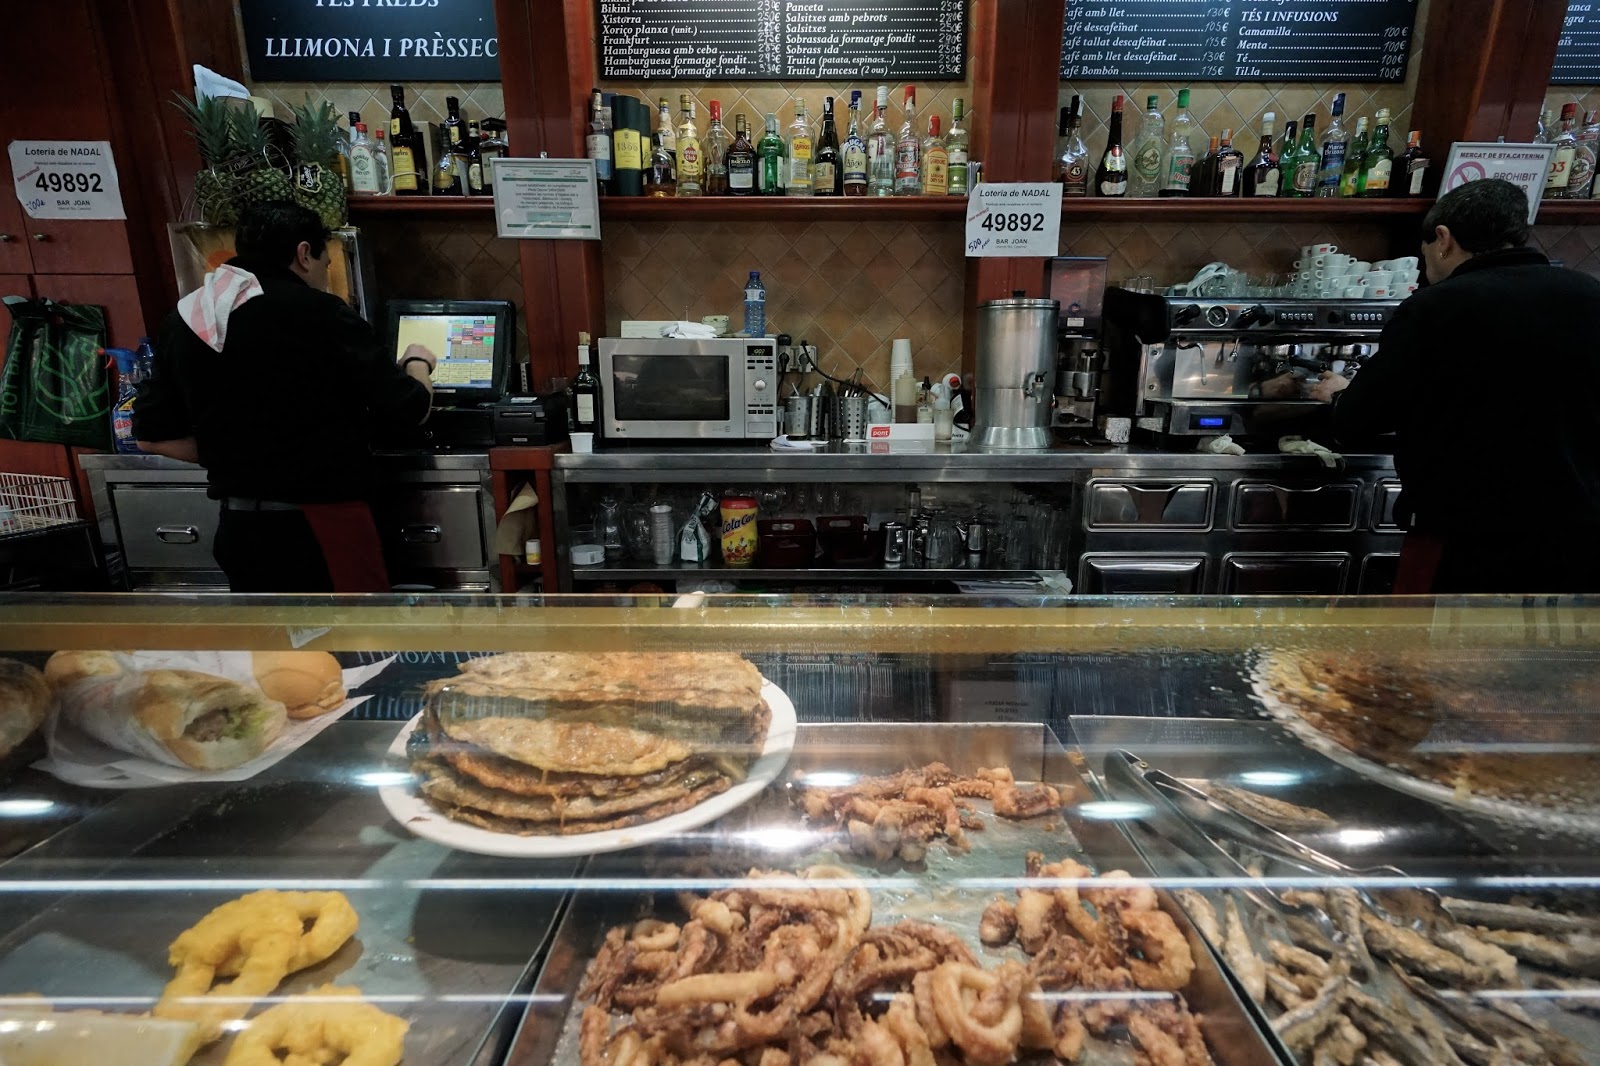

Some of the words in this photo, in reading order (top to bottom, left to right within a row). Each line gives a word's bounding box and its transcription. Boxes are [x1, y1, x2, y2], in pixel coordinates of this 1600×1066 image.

[600, 4, 630, 14] Bikini
[785, 2, 824, 12] Panceta
[1085, 8, 1106, 17] amb
[1109, 7, 1125, 17] llet
[1567, 4, 1592, 12] anca
[601, 15, 642, 24] Xistorra
[785, 13, 826, 23] Salsitxes
[829, 13, 850, 22] amb
[852, 13, 888, 25] pebrots
[1241, 8, 1262, 22] TÉS
[1263, 11, 1270, 22] I
[1271, 11, 1338, 22] INFUSIONS
[1564, 16, 1585, 27] egra
[602, 25, 633, 36] Xoriço
[634, 25, 668, 36] planxa
[671, 25, 698, 36] (unit.)
[786, 24, 827, 33] Salsitxes
[1084, 22, 1138, 35] descafeïnat
[1239, 26, 1291, 36] Camamilla
[265, 37, 376, 58] LLIMONA
[383, 38, 392, 57] I
[399, 31, 498, 58] PRÈSSEC
[602, 36, 650, 47] Frankfurt
[786, 34, 839, 44] Sobrassada
[839, 34, 885, 46] formatge
[884, 34, 916, 46] fondit
[1083, 36, 1110, 47] tallat
[1112, 36, 1166, 49] descafeïnat
[1237, 40, 1268, 50] Menta
[1557, 36, 1573, 46] aïs
[603, 46, 671, 58] Hamburguesa
[673, 47, 695, 55] amb
[696, 46, 718, 55] ceba
[1082, 51, 1103, 61] amb
[1105, 51, 1121, 61] llet
[1123, 51, 1177, 64] descafeïnat
[604, 57, 671, 68] Hamburguesa
[671, 56, 717, 68] formatge
[717, 56, 747, 68] fondit
[787, 56, 816, 65] Truita
[818, 55, 851, 67] (patata,
[1236, 53, 1249, 63] Té
[604, 67, 671, 78] Hamburguesa
[671, 66, 717, 78] formatge
[718, 66, 723, 75] i
[725, 66, 746, 75] ceba
[787, 66, 816, 75] Truita
[816, 66, 858, 78] francesa
[871, 66, 888, 76] ous)
[1081, 65, 1119, 76] Bombón
[1235, 66, 1260, 76] Til.la
[25, 147, 55, 156] Loteria
[57, 147, 68, 156] de
[70, 148, 101, 156] NADAL
[1071, 166, 1081, 176] 43
[1493, 172, 1538, 181] PROHIBIT
[35, 172, 104, 193] 49892
[980, 189, 1008, 197] Loteria
[1009, 189, 1020, 197] de
[1021, 189, 1051, 197] NADAL
[981, 212, 1045, 232] 49892
[968, 237, 982, 253] 500
[872, 428, 889, 437] pont
[722, 519, 741, 534] Cola
